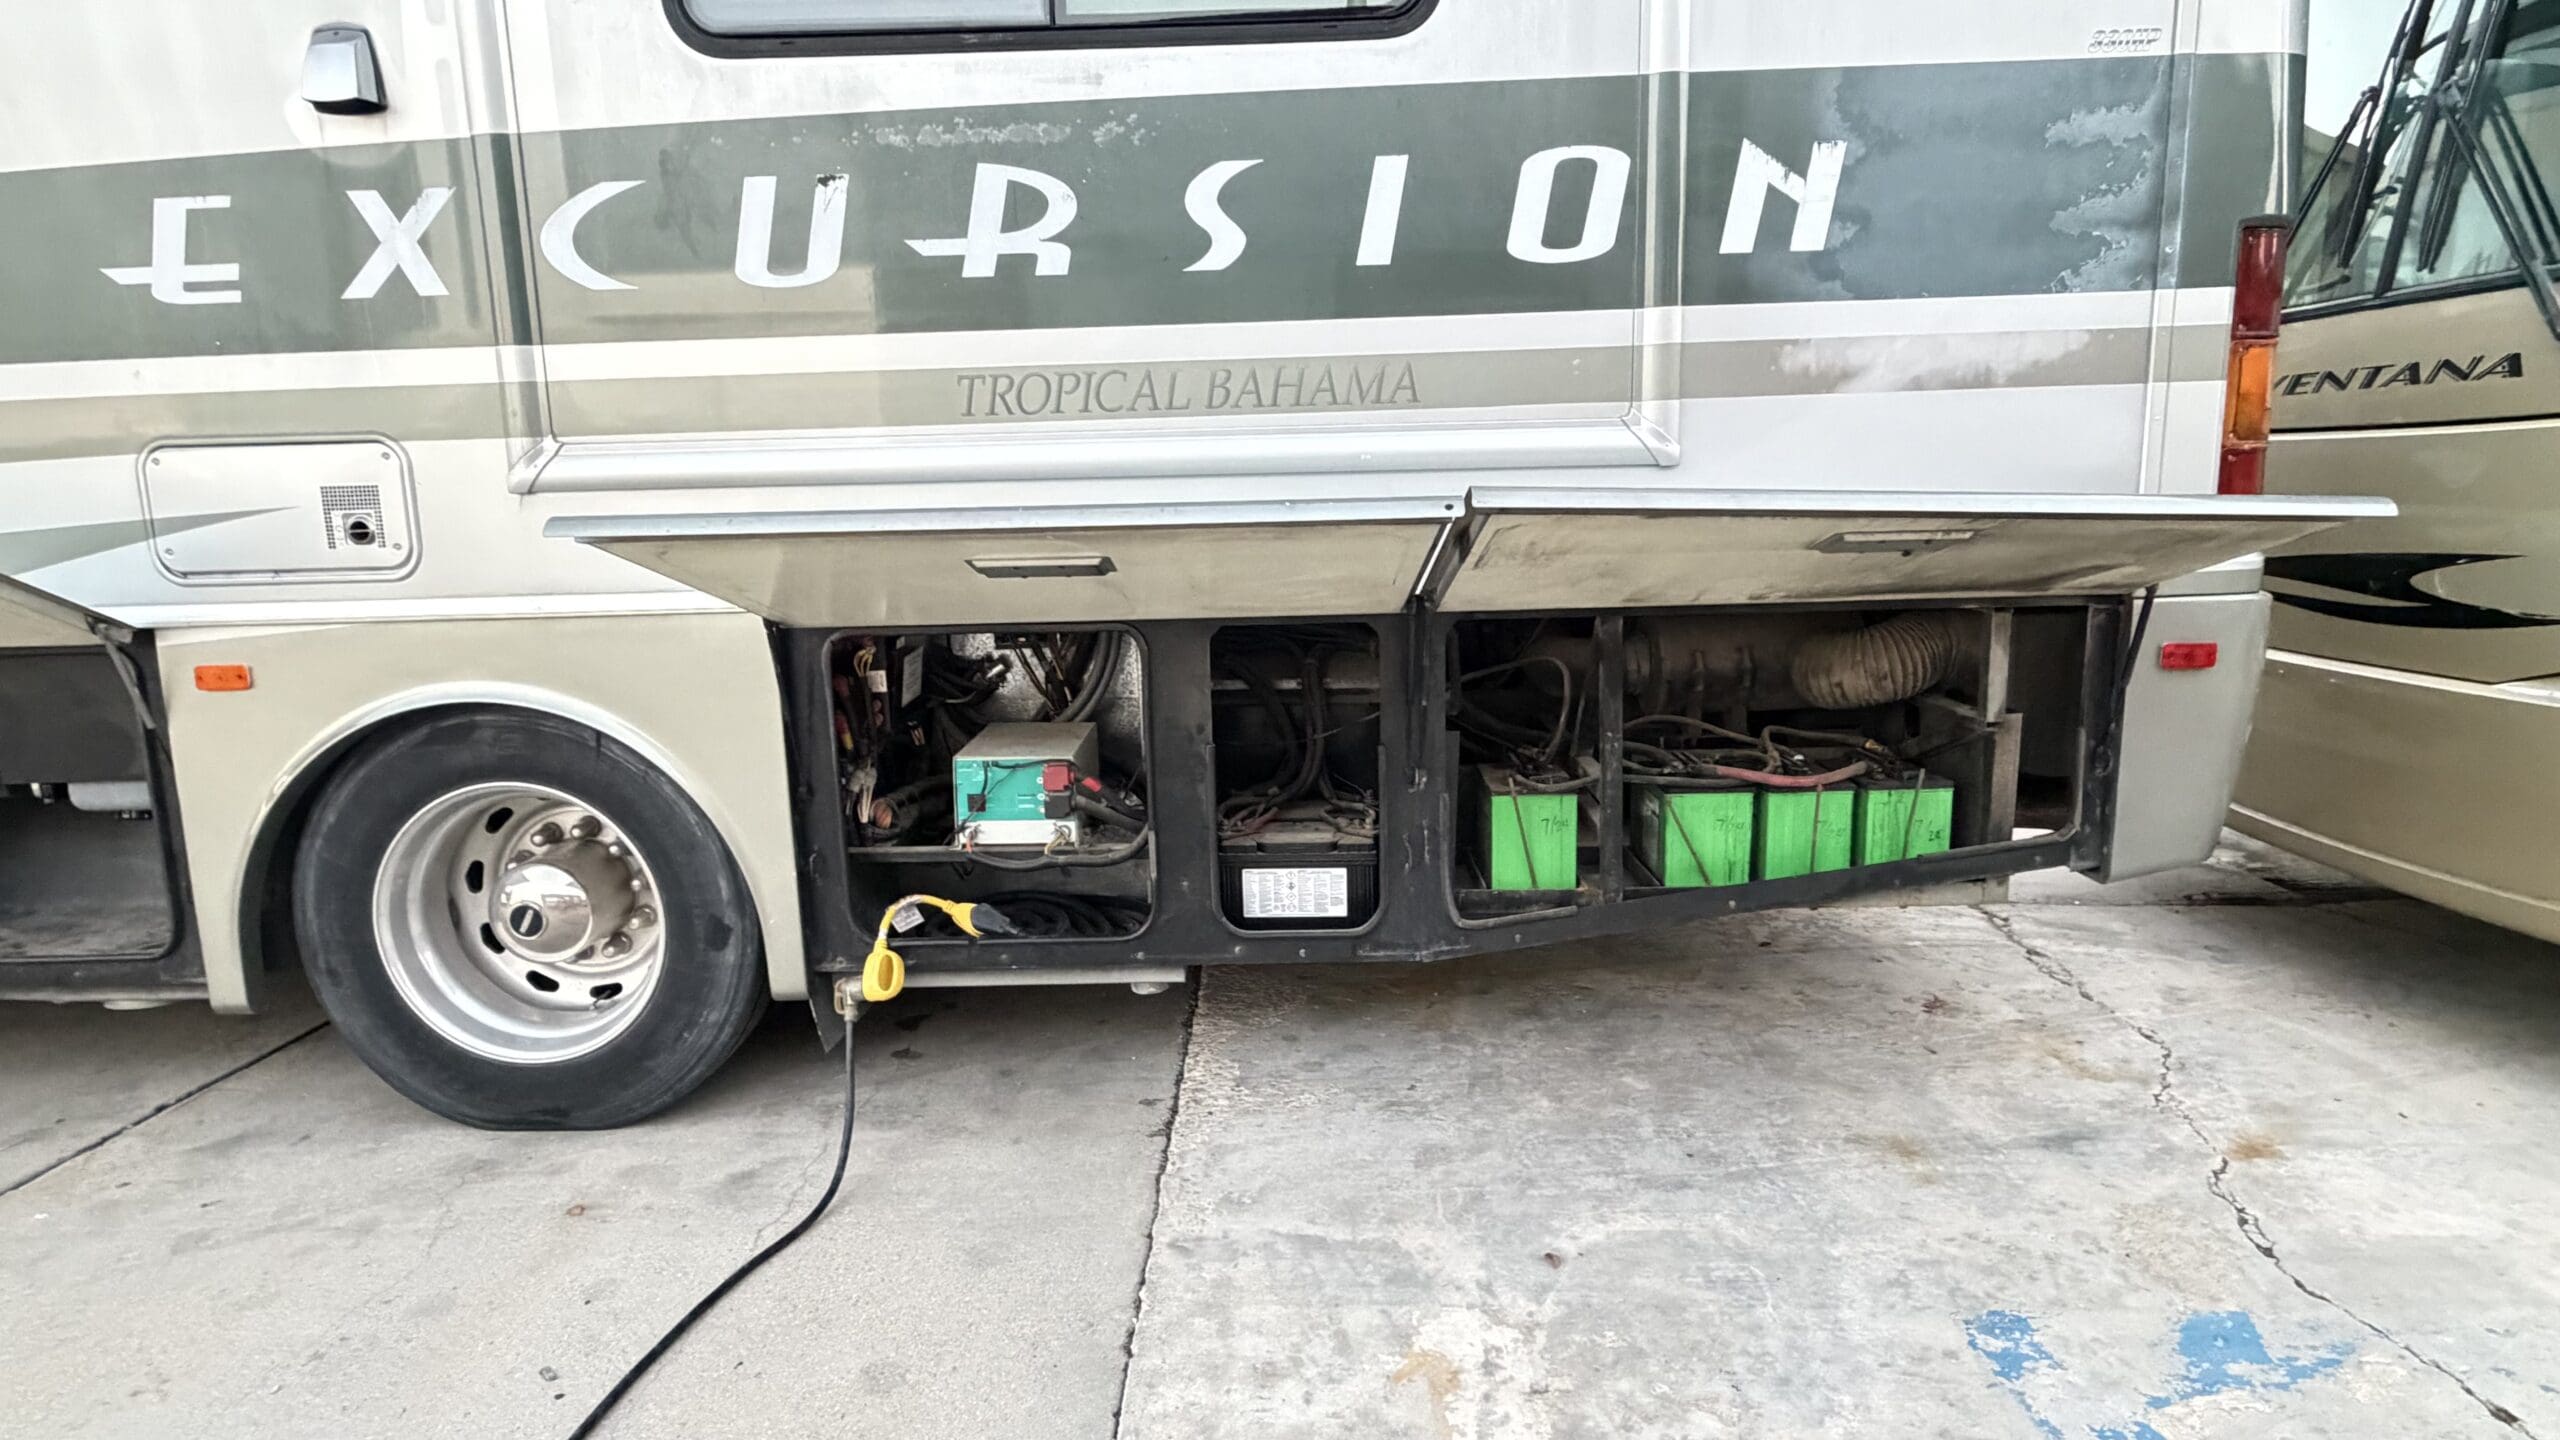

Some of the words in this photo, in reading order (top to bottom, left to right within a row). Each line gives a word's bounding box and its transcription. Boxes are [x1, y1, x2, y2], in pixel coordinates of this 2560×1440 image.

[100, 137, 1848, 305] EXCURSION
[957, 368, 1191, 417] TROPICAL
[1204, 360, 1421, 409] BAHAMA
